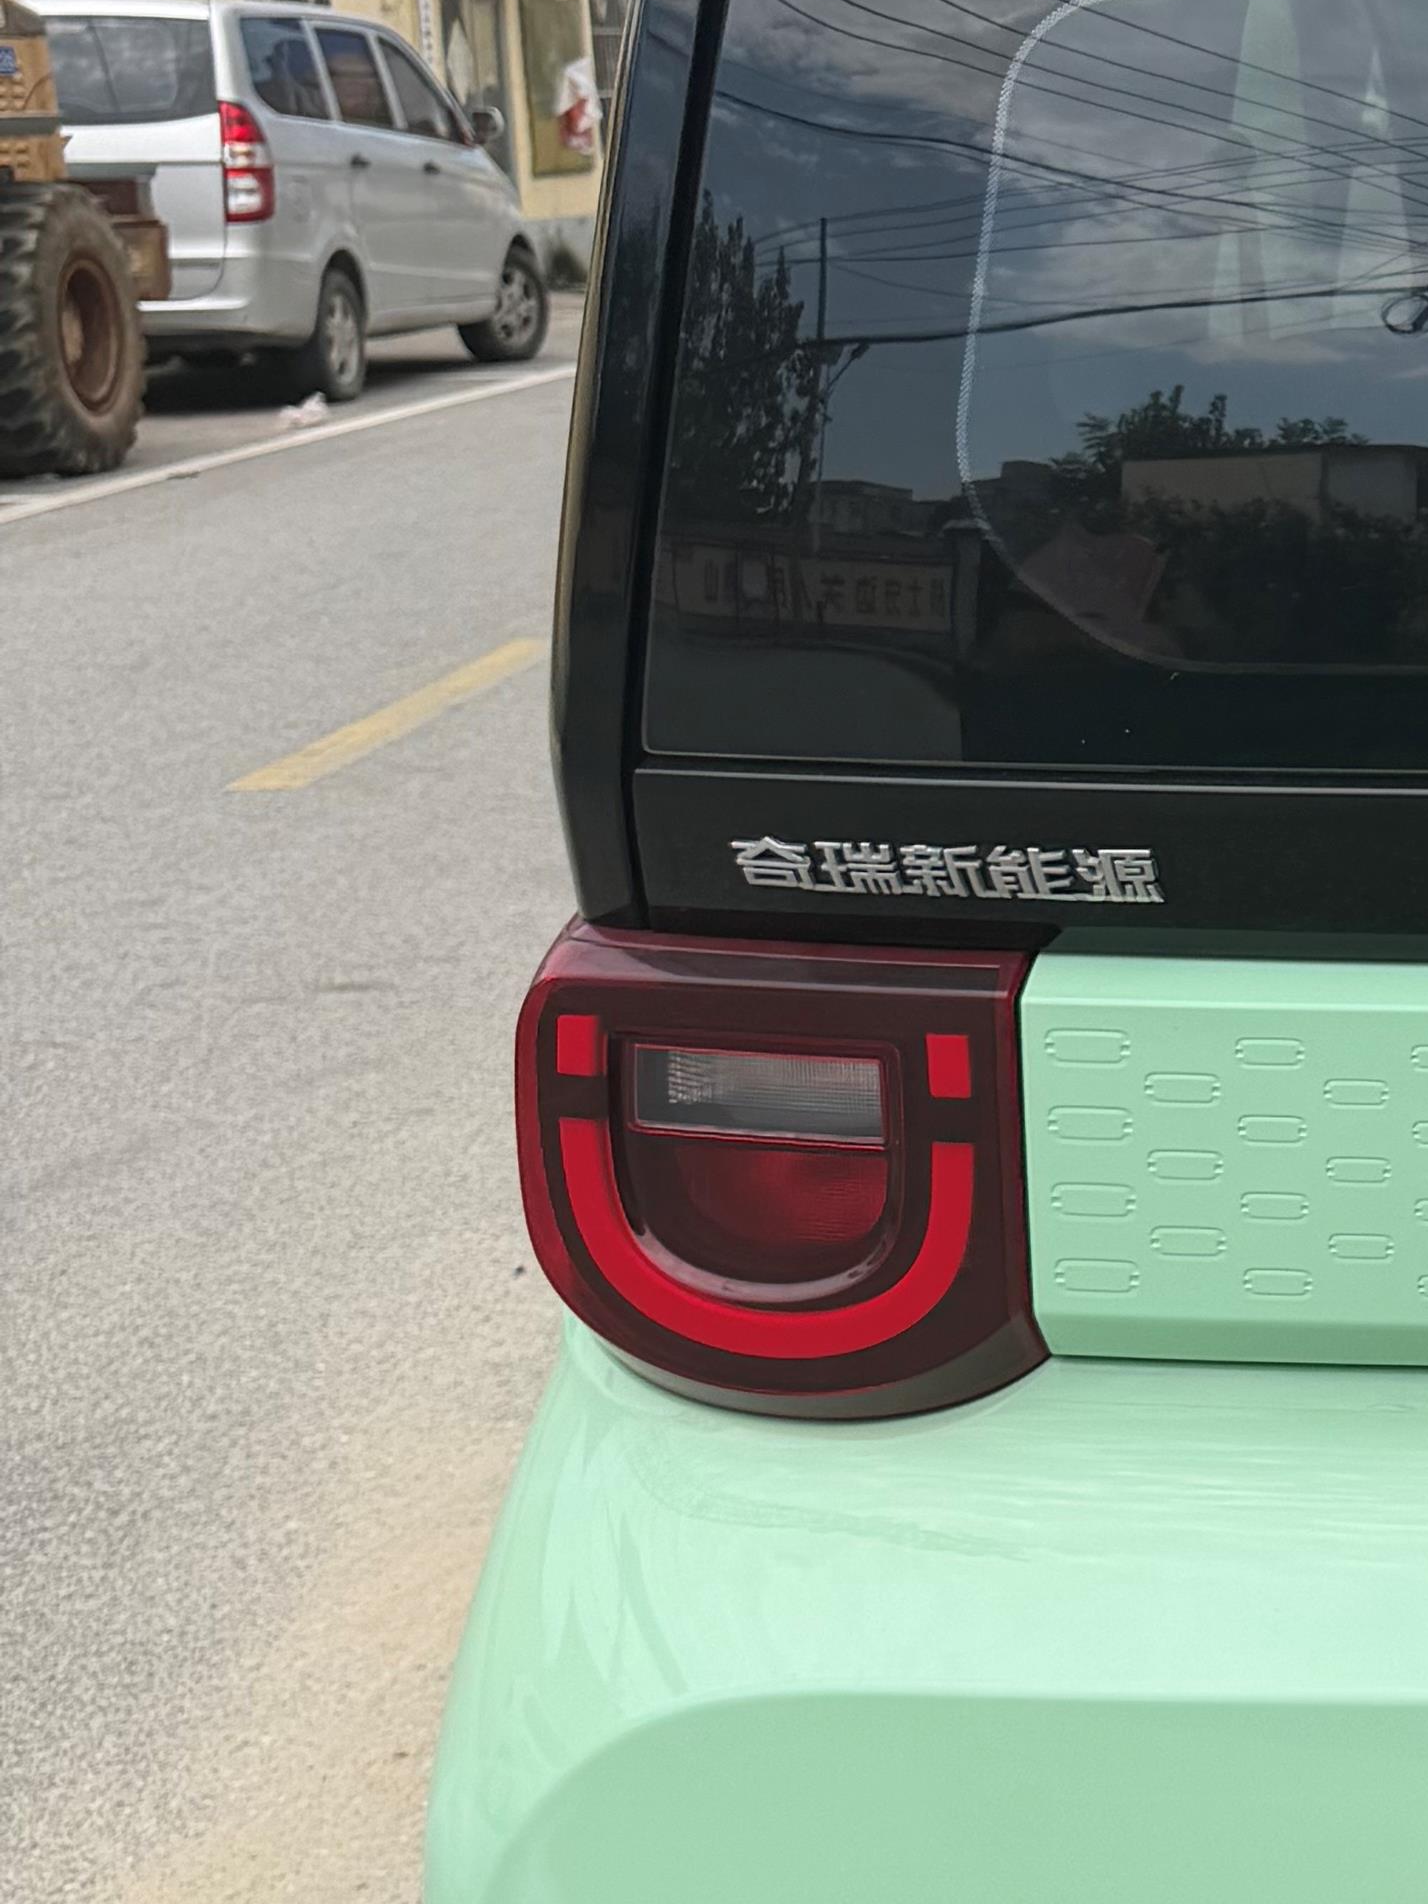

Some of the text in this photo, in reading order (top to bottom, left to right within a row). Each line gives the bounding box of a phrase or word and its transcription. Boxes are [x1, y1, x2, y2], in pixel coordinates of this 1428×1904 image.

[730, 835, 1166, 904] 奇瑞新能源
